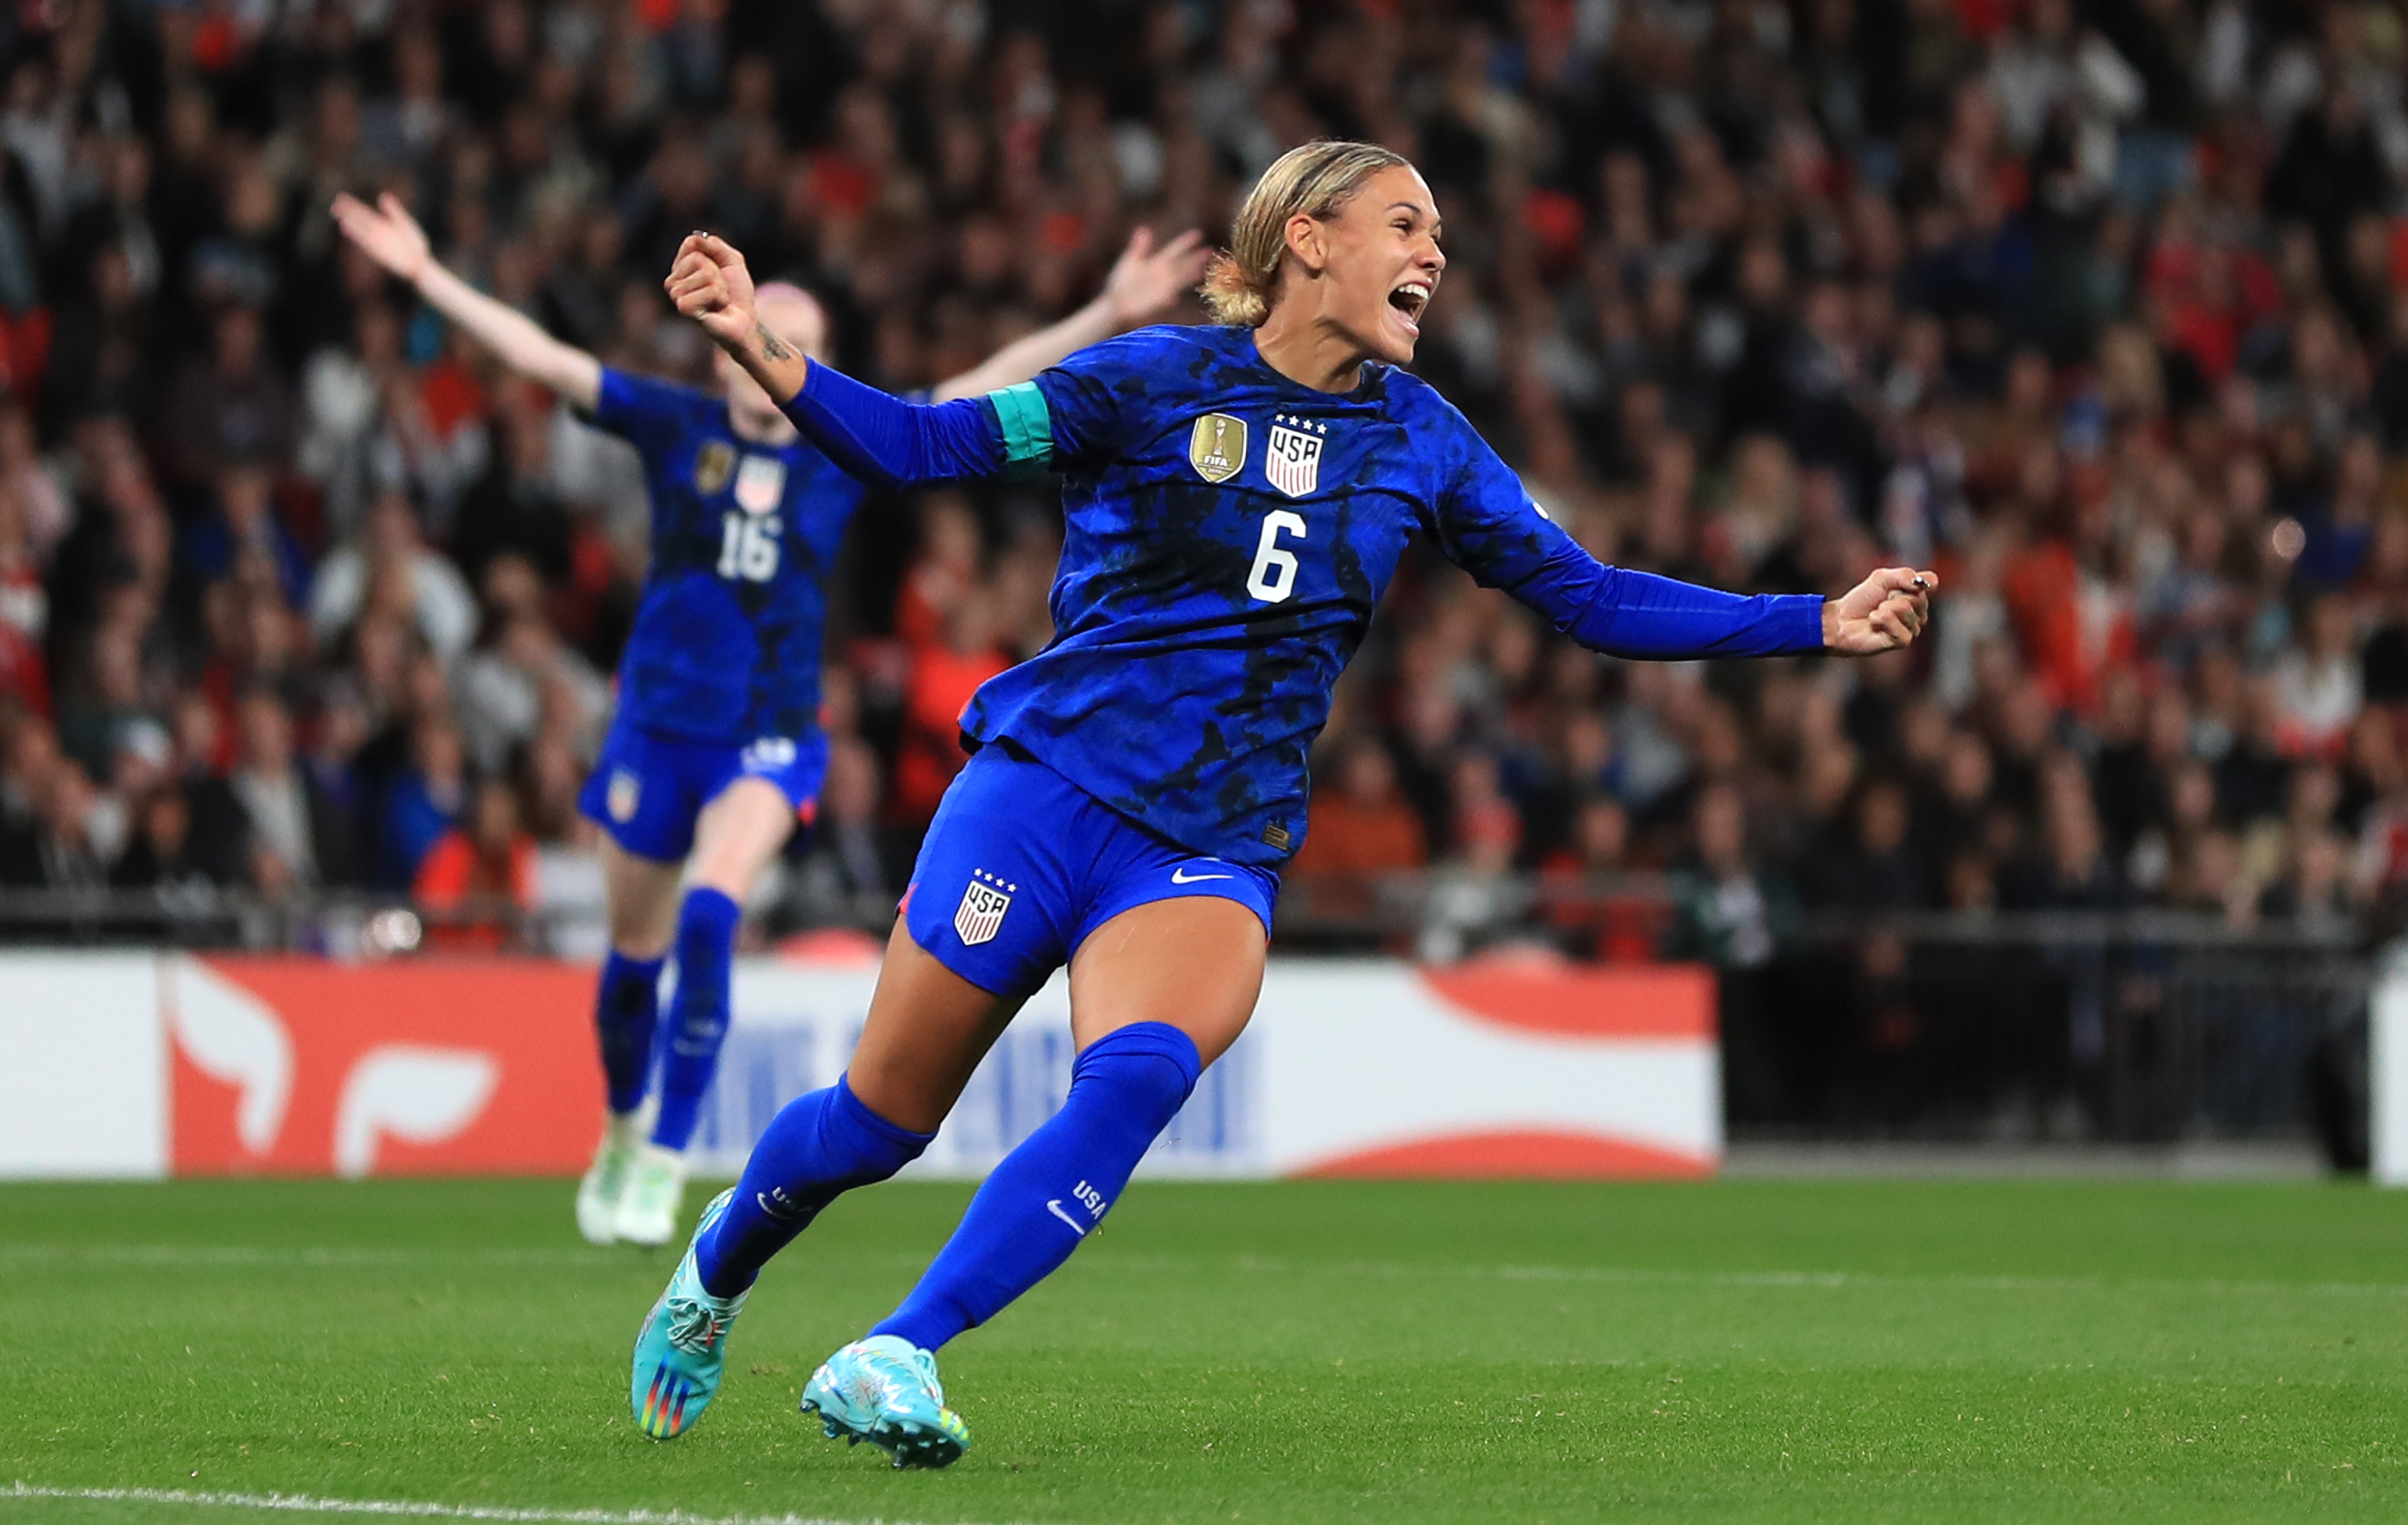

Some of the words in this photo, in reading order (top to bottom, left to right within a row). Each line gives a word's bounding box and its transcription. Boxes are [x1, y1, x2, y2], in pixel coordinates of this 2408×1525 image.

[1204, 455, 1229, 467] FIFA
[1272, 429, 1318, 463] USA
[716, 511, 784, 582] 16
[1246, 509, 1306, 604] 6
[968, 884, 1006, 913] USA
[1072, 1179, 1106, 1220] USA
